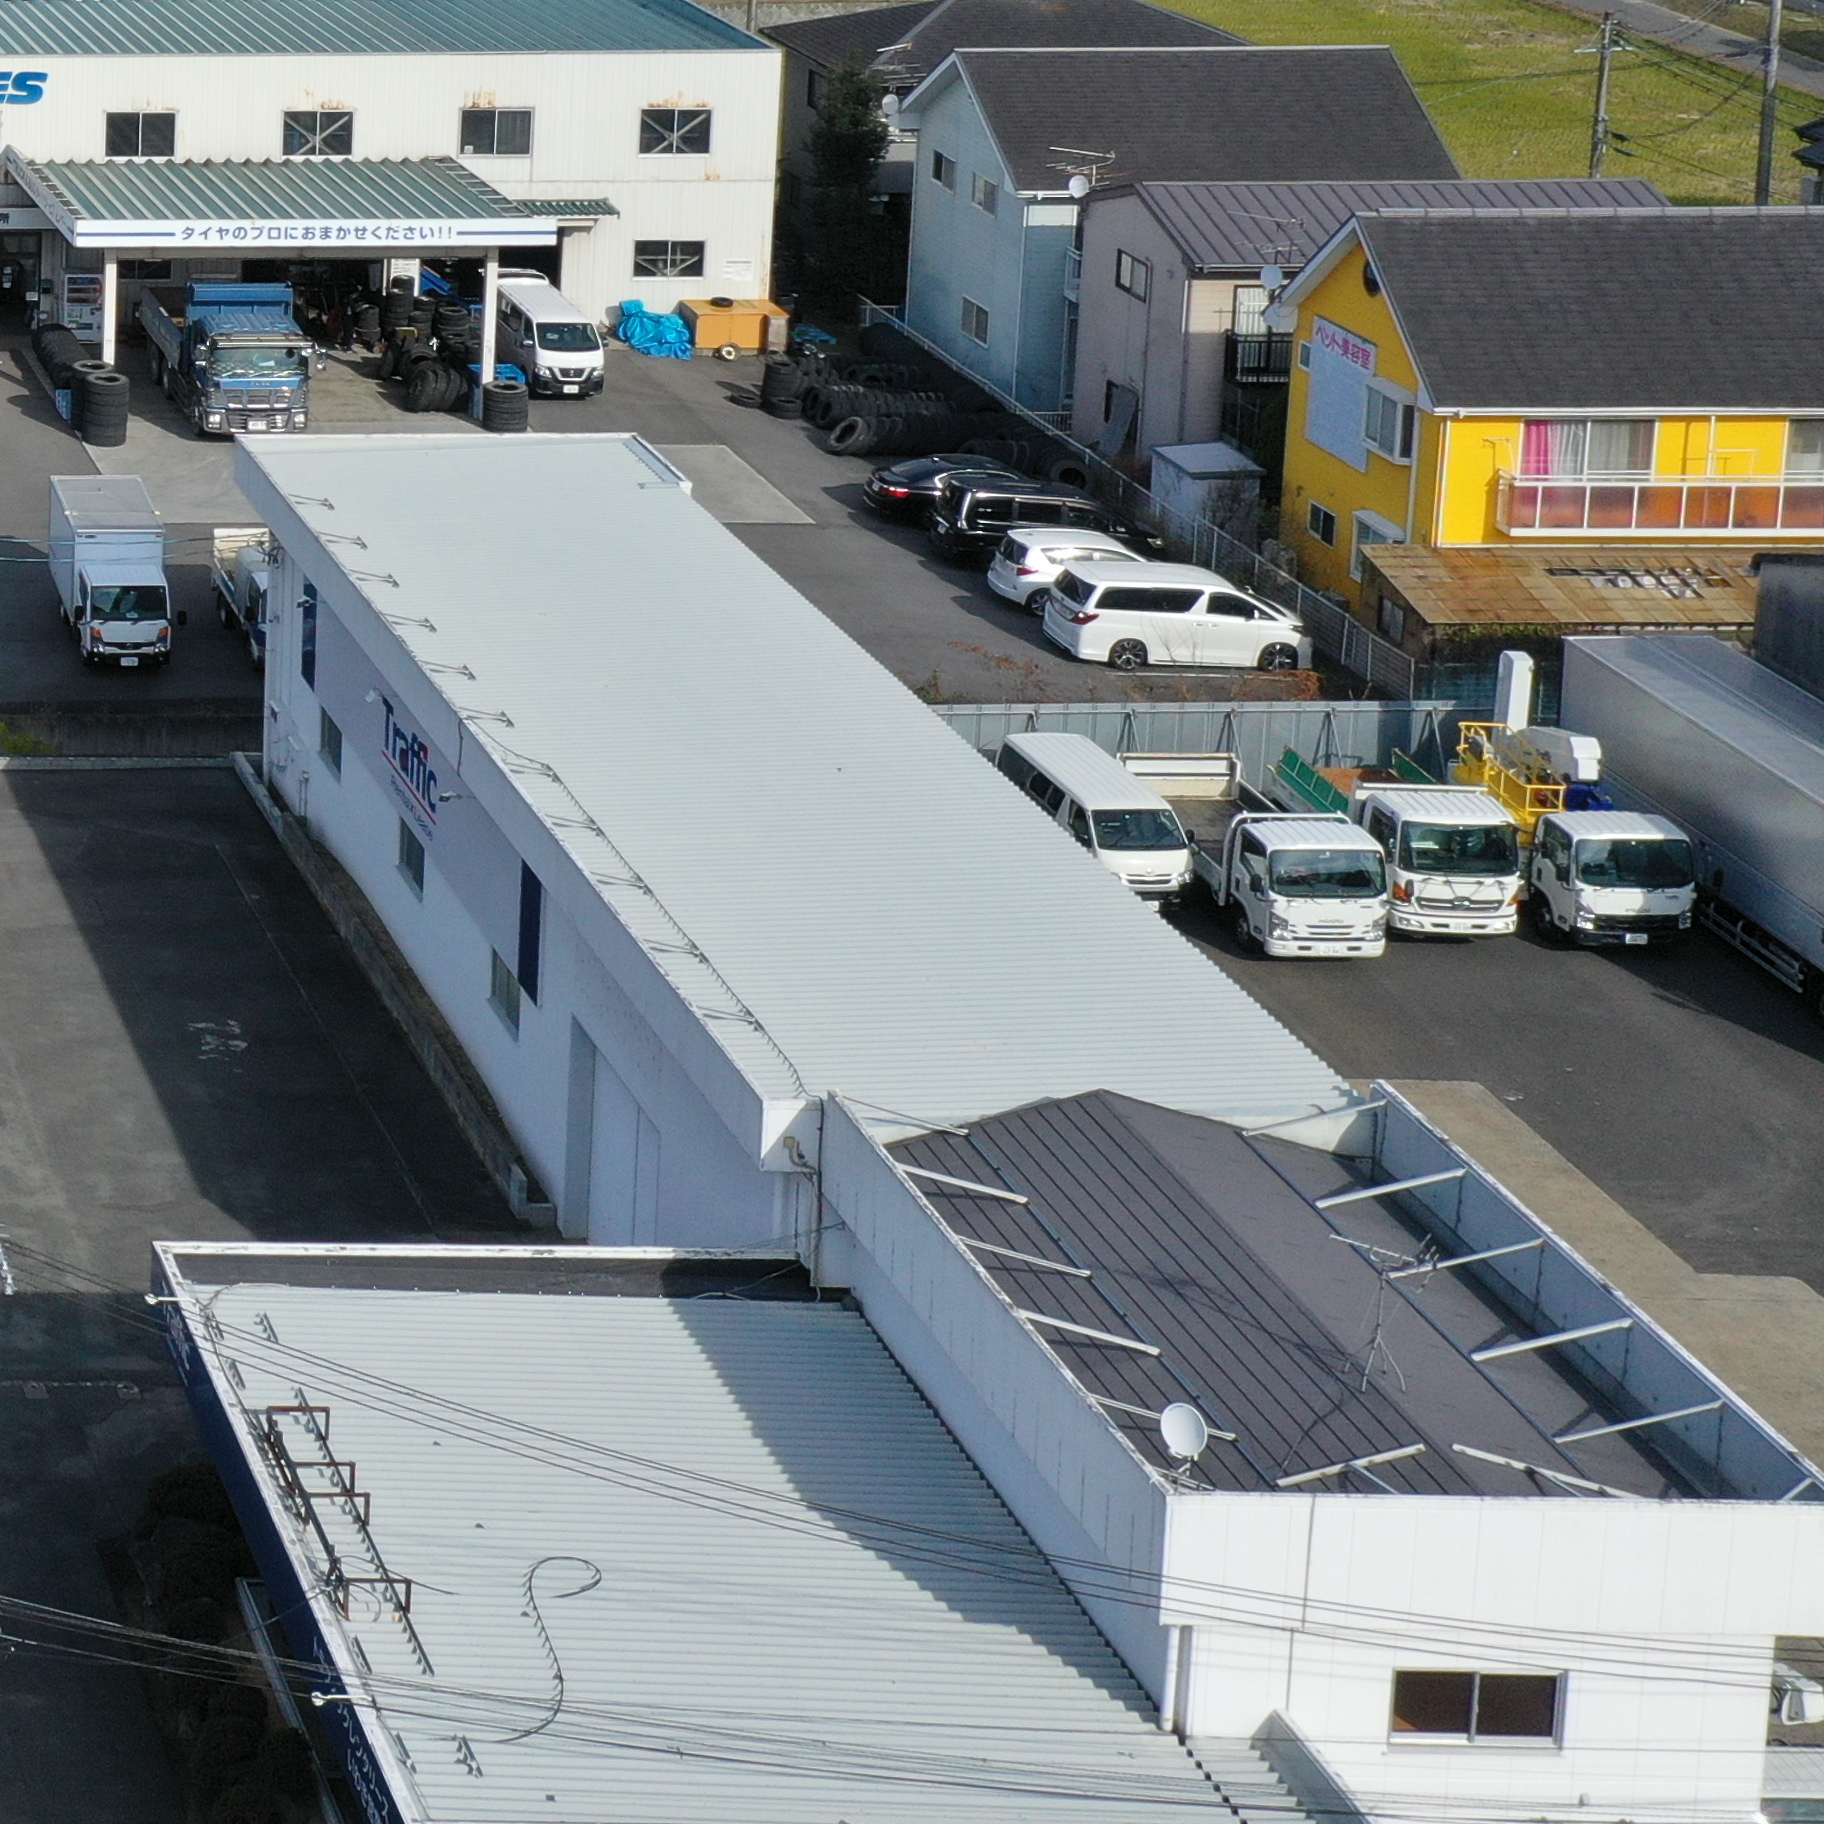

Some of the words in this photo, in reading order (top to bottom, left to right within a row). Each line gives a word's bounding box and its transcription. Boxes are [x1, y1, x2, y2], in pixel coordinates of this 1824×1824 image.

[1315, 326, 1372, 371] ペット美容室
[382, 695, 438, 814] Traffic
